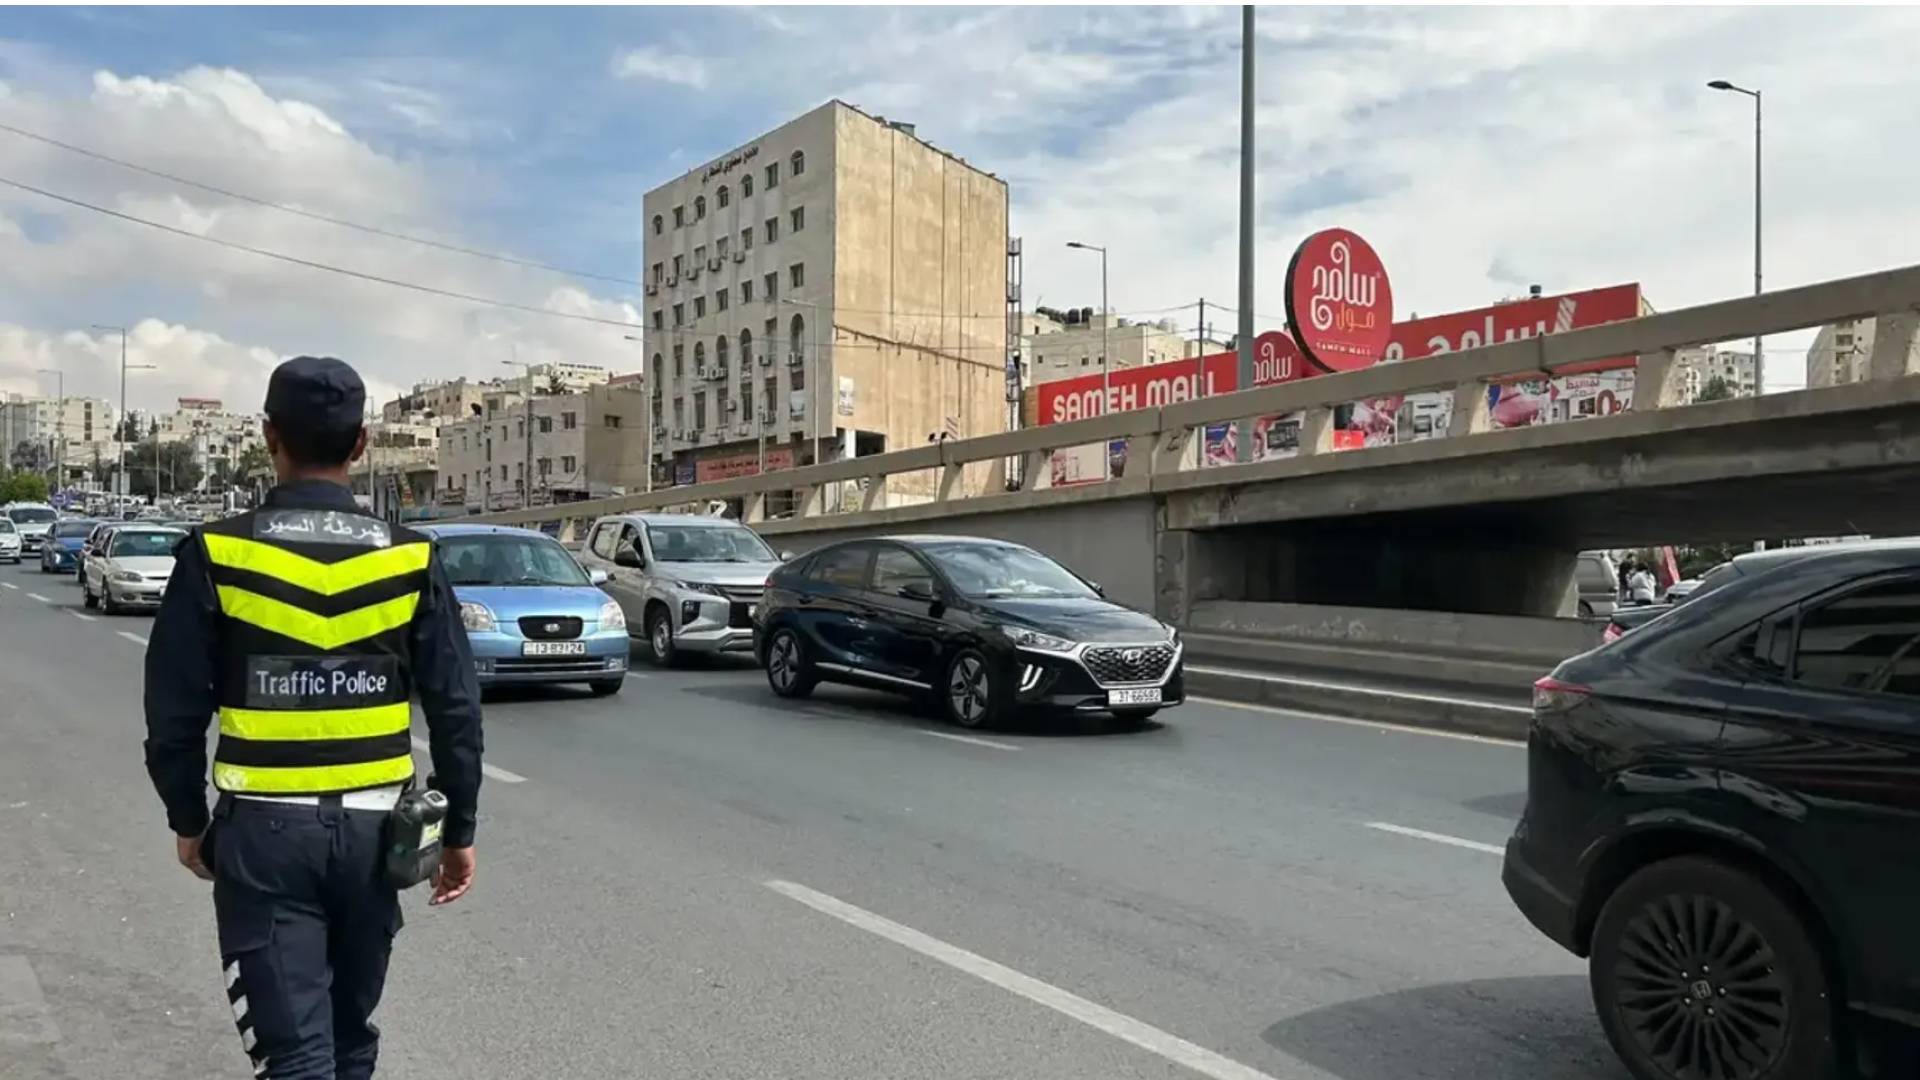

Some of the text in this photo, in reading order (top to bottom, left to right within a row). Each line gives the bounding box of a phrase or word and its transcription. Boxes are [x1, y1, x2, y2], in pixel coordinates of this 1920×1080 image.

[1311, 240, 1376, 331] سامح
[1336, 302, 1375, 332] مول
[1053, 371, 1217, 423] SAMEH MALL
[261, 511, 385, 540] شرطة السير
[256, 670, 387, 695] Traffic Police
